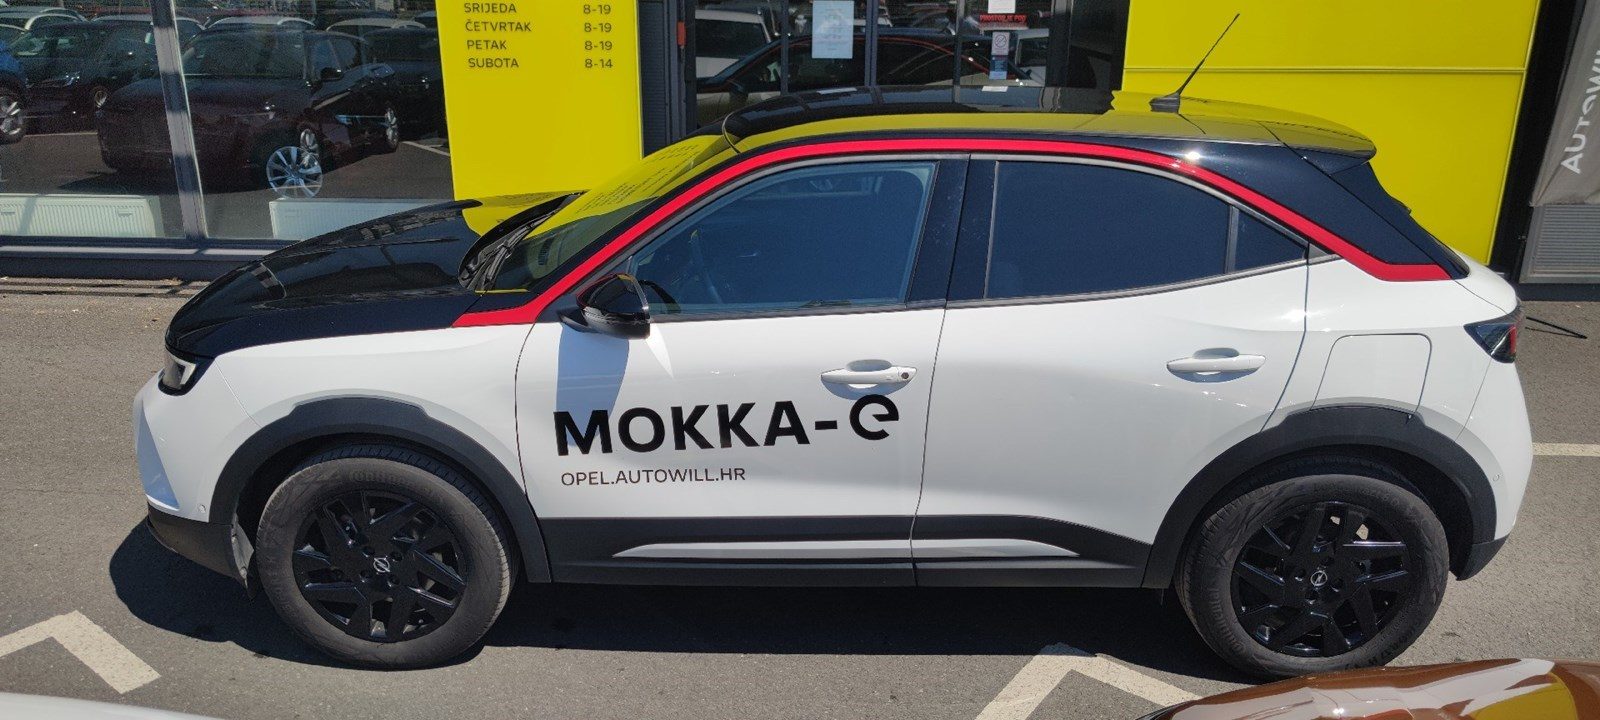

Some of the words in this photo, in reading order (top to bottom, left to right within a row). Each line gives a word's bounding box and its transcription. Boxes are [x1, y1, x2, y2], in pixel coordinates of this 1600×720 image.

[464, 2, 517, 13] SRIJEDA
[583, 4, 611, 15] 8-19
[465, 18, 532, 32] ČETVRTAK
[583, 22, 612, 33] 8-19
[466, 39, 507, 50] PETAK
[584, 40, 613, 51] 8-19
[468, 57, 520, 68] SUBOTA
[584, 58, 613, 69] 8-14
[561, 467, 746, 486] OPEL.AUTOWILL.HR
